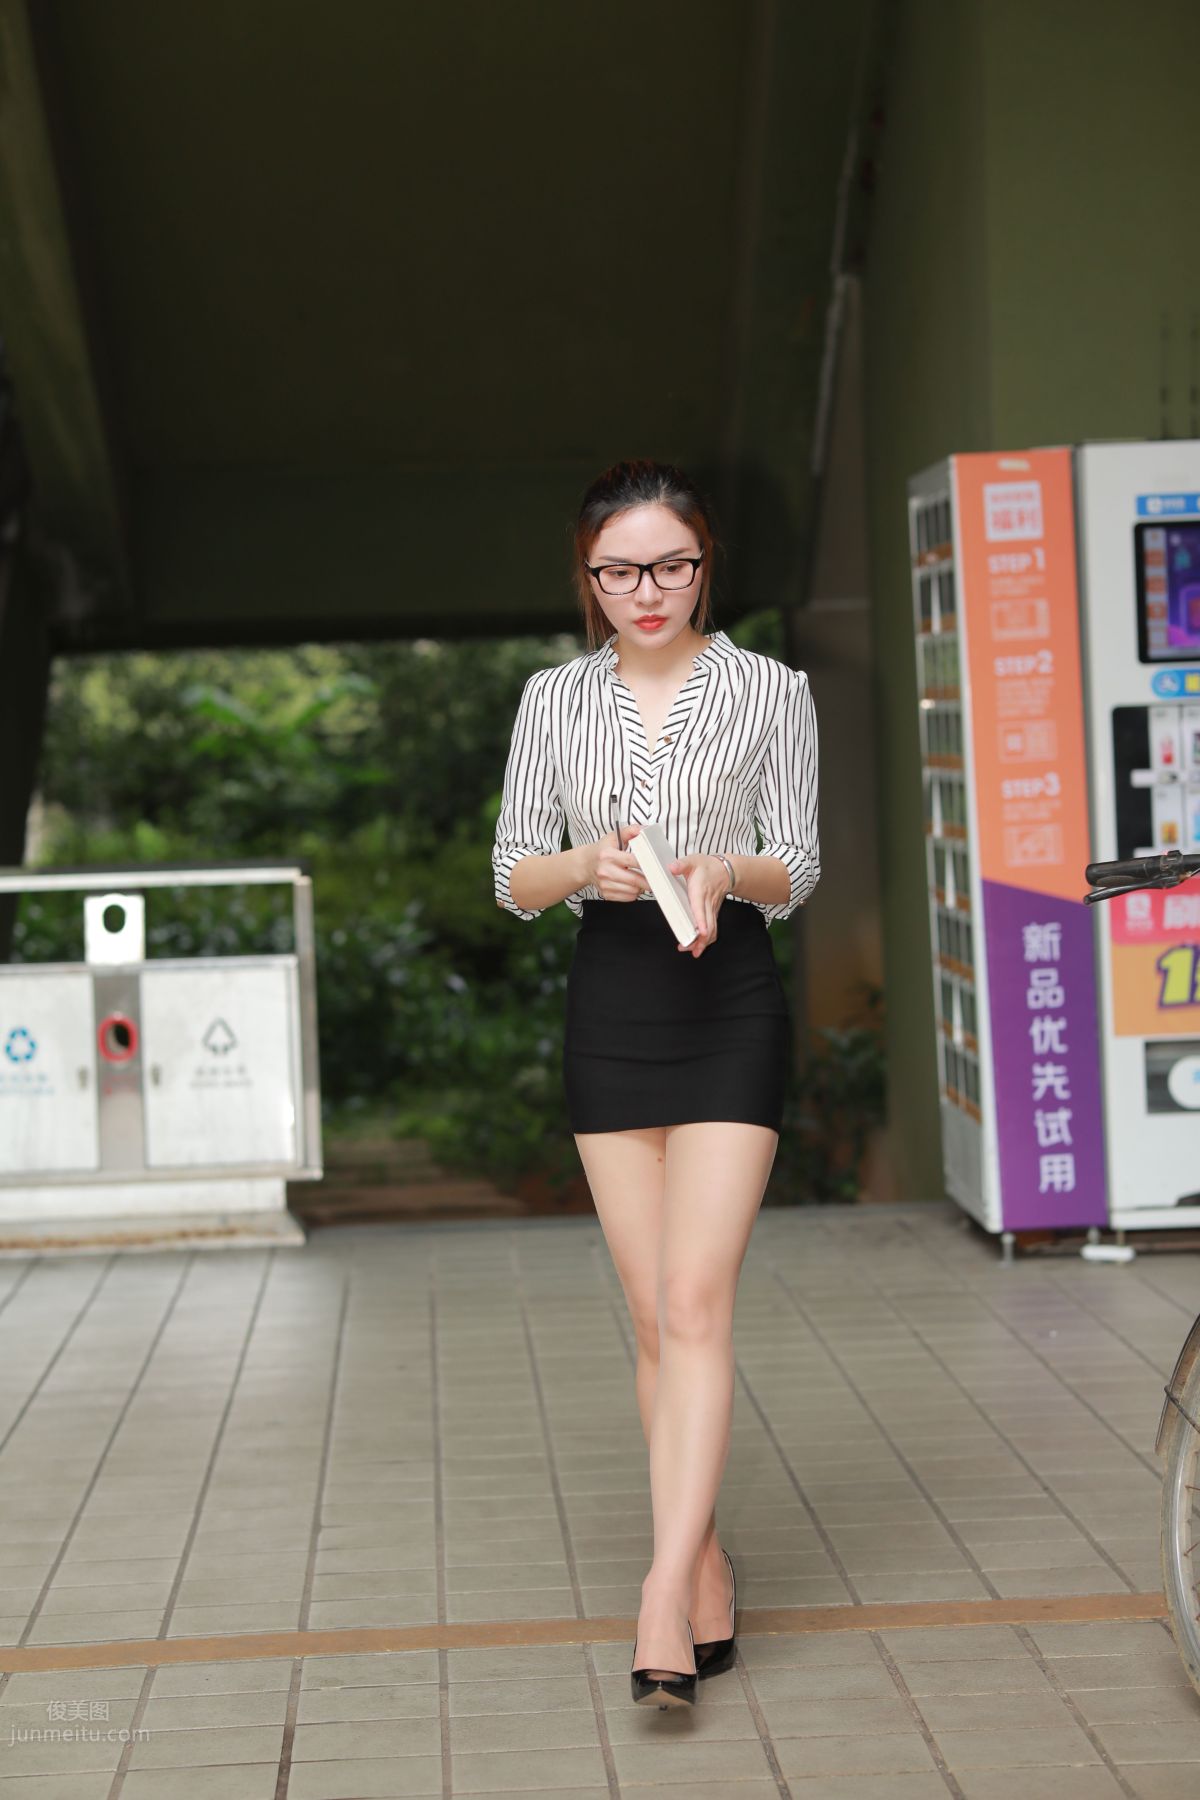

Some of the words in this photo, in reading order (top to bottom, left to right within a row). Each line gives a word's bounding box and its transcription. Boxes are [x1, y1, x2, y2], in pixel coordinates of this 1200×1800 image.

[1022, 922, 1075, 1193] 新品优先试用
